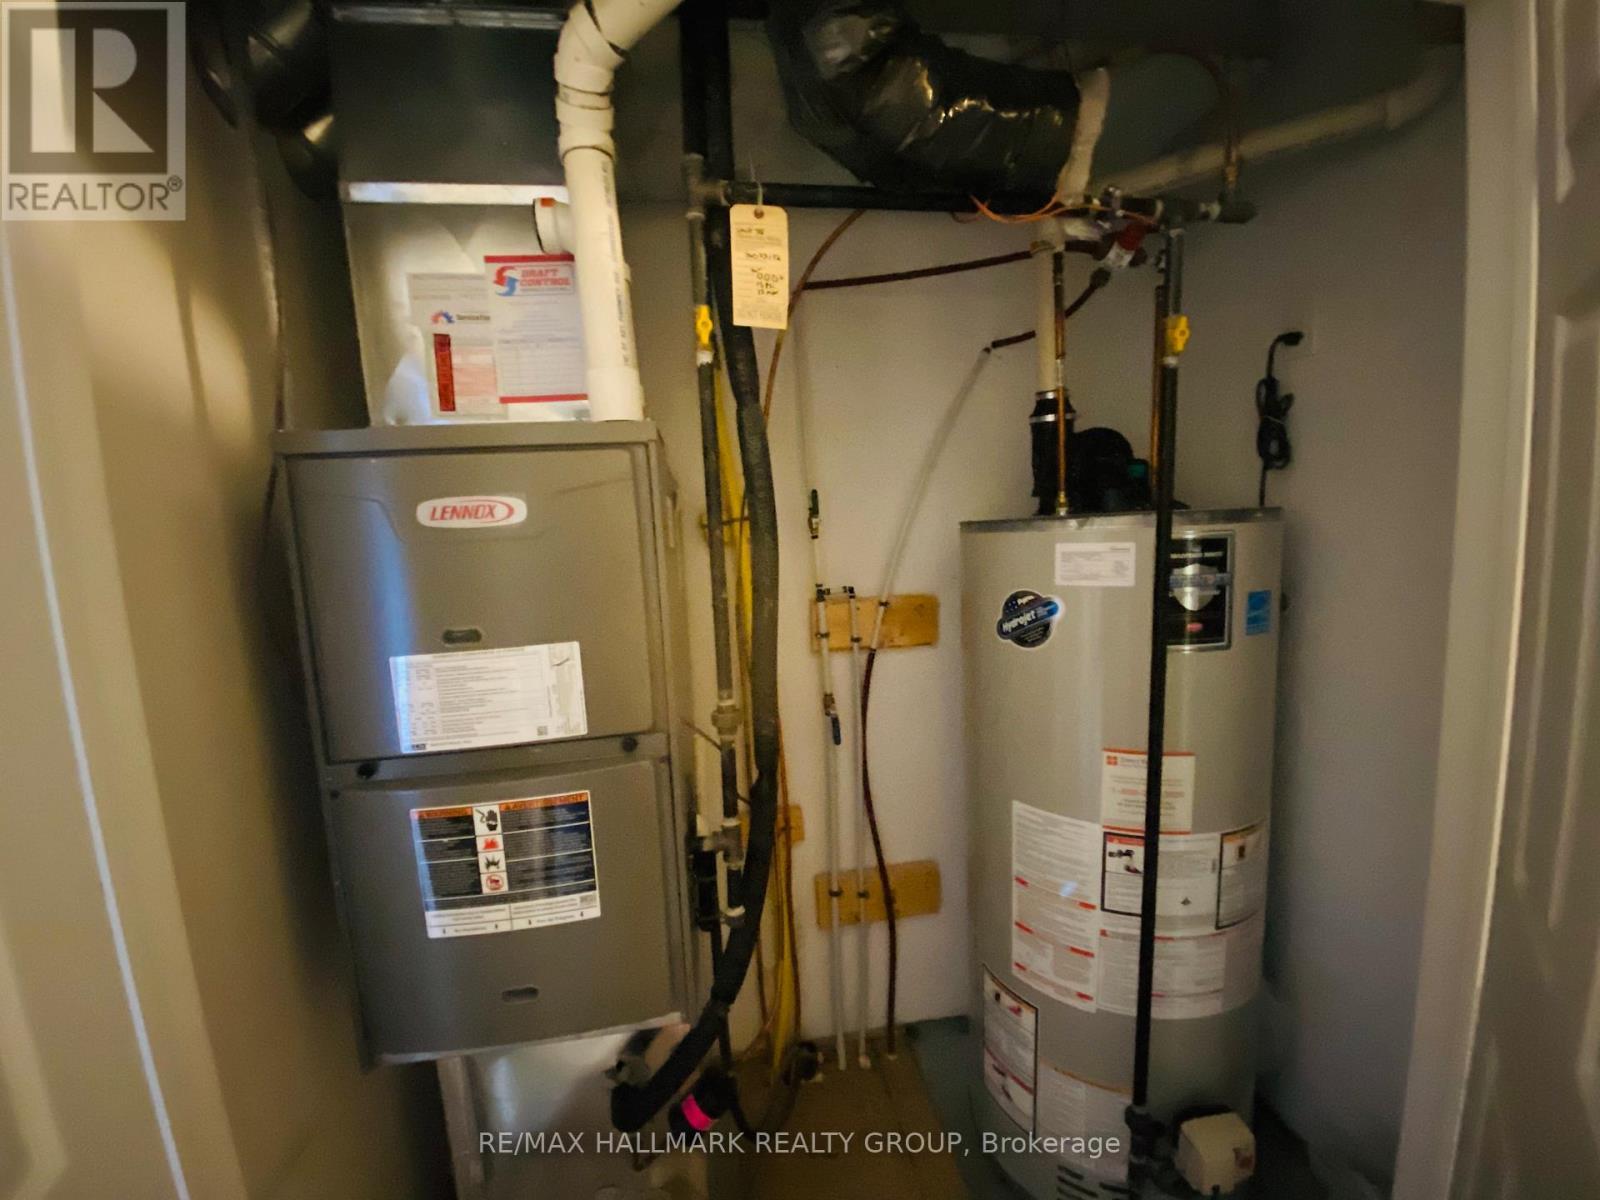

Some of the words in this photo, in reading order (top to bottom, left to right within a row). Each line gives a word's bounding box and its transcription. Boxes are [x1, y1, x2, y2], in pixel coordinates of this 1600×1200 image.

[521, 269, 559, 278] DRAFT
[520, 278, 571, 287] CONTROL
[430, 503, 497, 521] LENNOX
